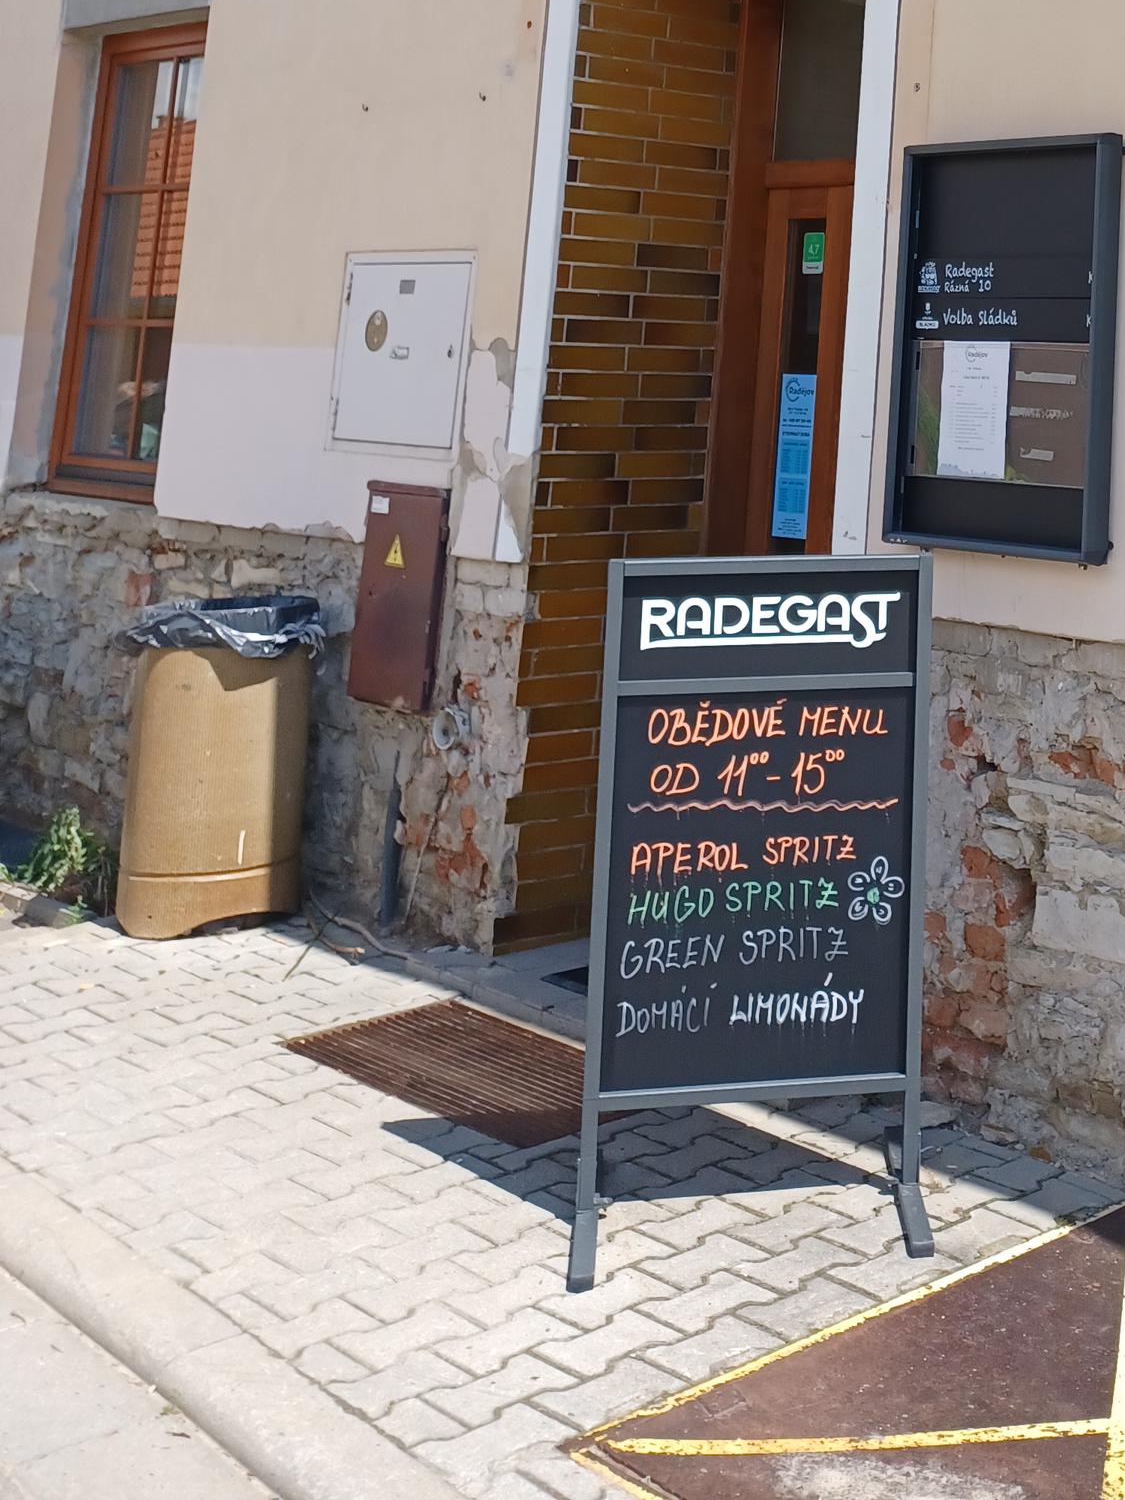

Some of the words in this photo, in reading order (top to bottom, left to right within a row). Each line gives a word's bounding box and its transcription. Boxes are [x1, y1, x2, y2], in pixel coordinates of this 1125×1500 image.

[944, 280, 970, 293] Rázná
[978, 280, 992, 292] 10
[945, 262, 994, 281] Radegast
[943, 308, 974, 326] Volba
[640, 592, 901, 651] RADEGAST
[648, 698, 787, 747] OBĚDOVÉ
[799, 706, 888, 737] MENU
[650, 763, 700, 795] OD
[630, 842, 748, 876] APEROL
[763, 835, 857, 866] SPRITZ
[627, 886, 714, 925] HUGO
[725, 877, 839, 912] SPRITZ
[620, 934, 725, 979] GREEN
[739, 926, 848, 965] SPRITZ
[729, 972, 864, 1025] LIMONÁDY
